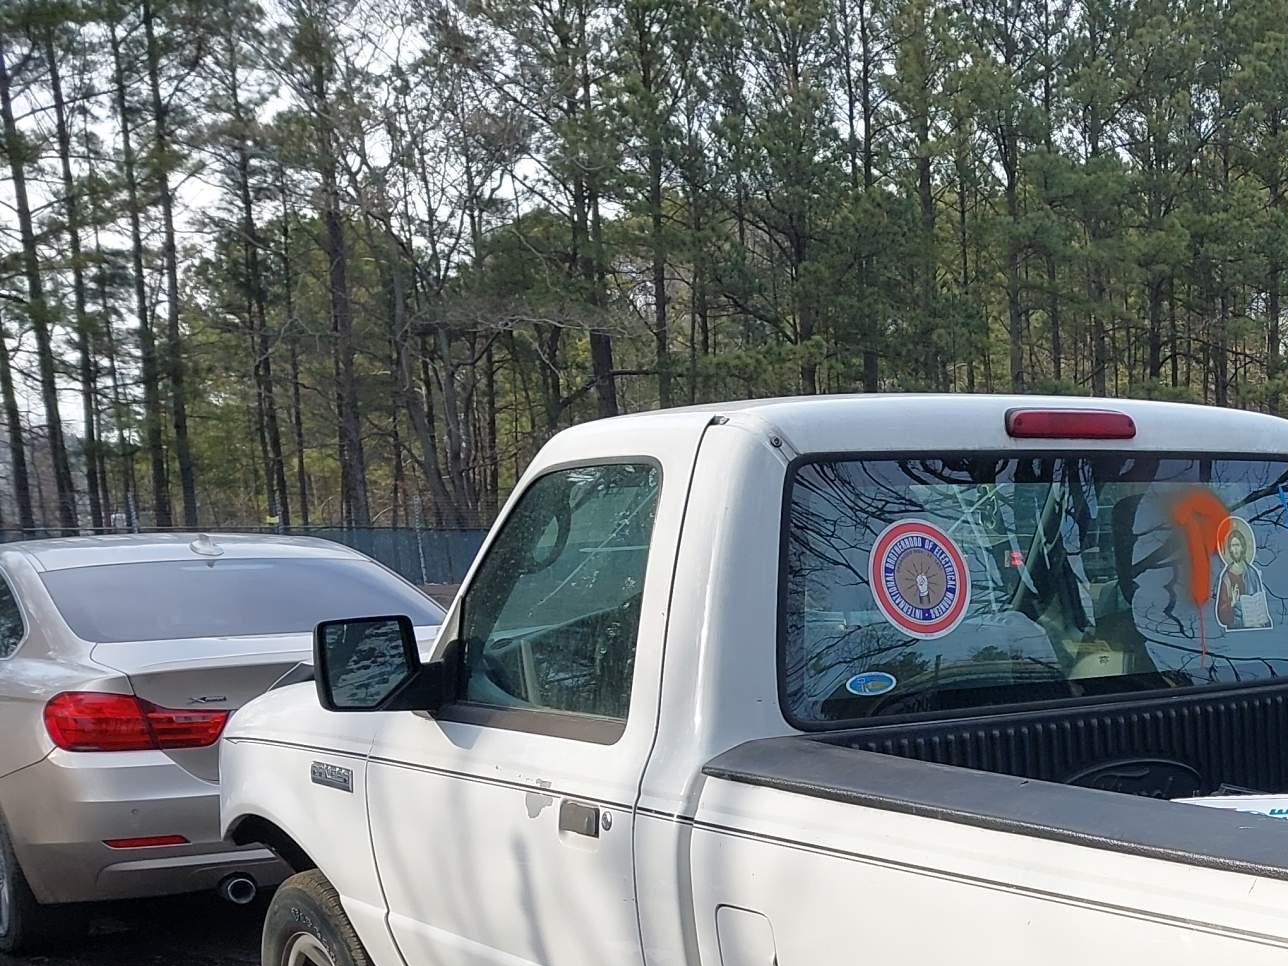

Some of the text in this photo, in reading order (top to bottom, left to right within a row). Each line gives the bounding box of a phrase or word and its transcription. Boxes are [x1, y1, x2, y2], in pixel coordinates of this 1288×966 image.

[886, 535, 923, 569] BROTHERHOOD
[924, 538, 934, 549] OF
[934, 546, 957, 588] ELECTRICAL
[886, 572, 923, 620] INTERNATIONAL
[930, 588, 956, 619] WORKERS
